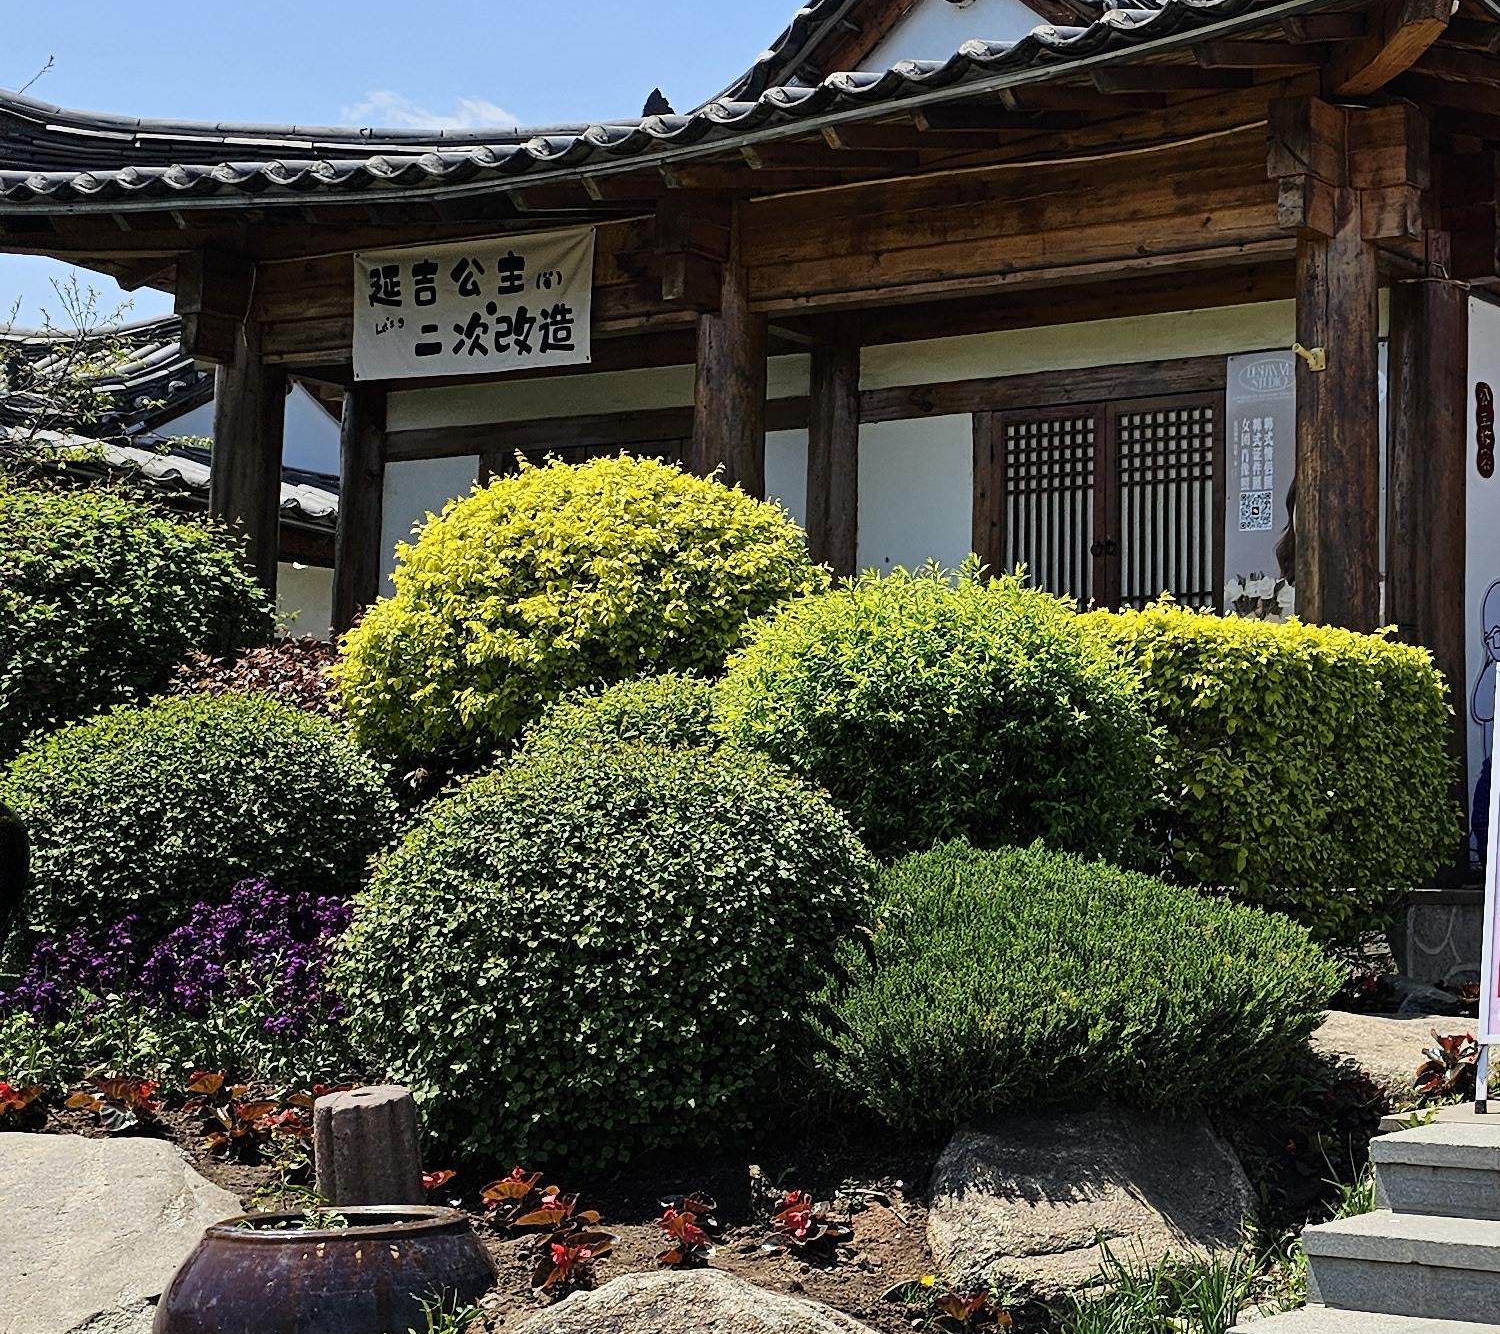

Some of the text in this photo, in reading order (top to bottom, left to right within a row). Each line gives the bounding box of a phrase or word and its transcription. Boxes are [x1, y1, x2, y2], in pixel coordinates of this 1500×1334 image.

[368, 249, 526, 307] 延吉公主
[414, 301, 576, 357] 二次改造
